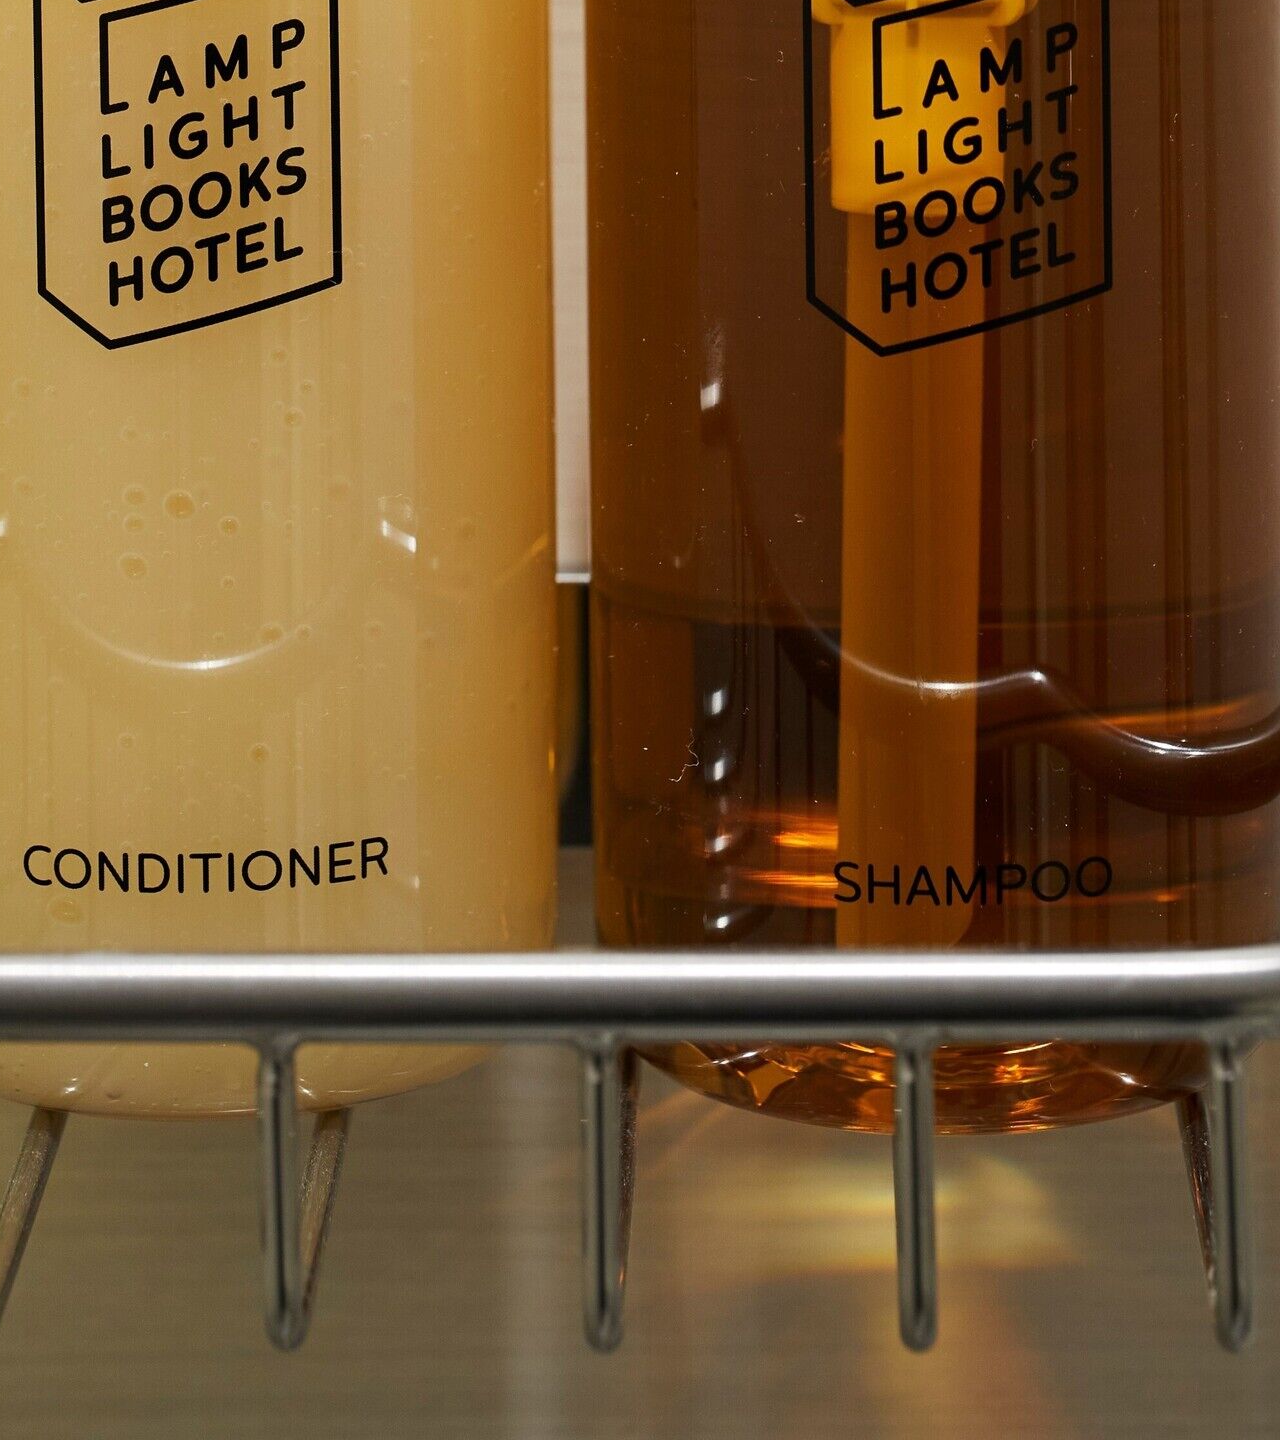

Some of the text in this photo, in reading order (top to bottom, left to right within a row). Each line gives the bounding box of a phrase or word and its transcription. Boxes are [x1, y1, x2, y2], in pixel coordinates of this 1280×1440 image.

[99, 14, 305, 115] LAMP
[872, 17, 1078, 120] LAMP
[101, 80, 306, 180] LIGHT
[874, 84, 1079, 185] LIGHT
[102, 146, 307, 244] BOOKS
[874, 151, 1079, 250] BOOKS
[108, 216, 304, 307] HOTEL
[881, 222, 1075, 314] HOTEL
[23, 836, 389, 894] CONDITIONER
[833, 855, 1113, 907] SHAMPOO
